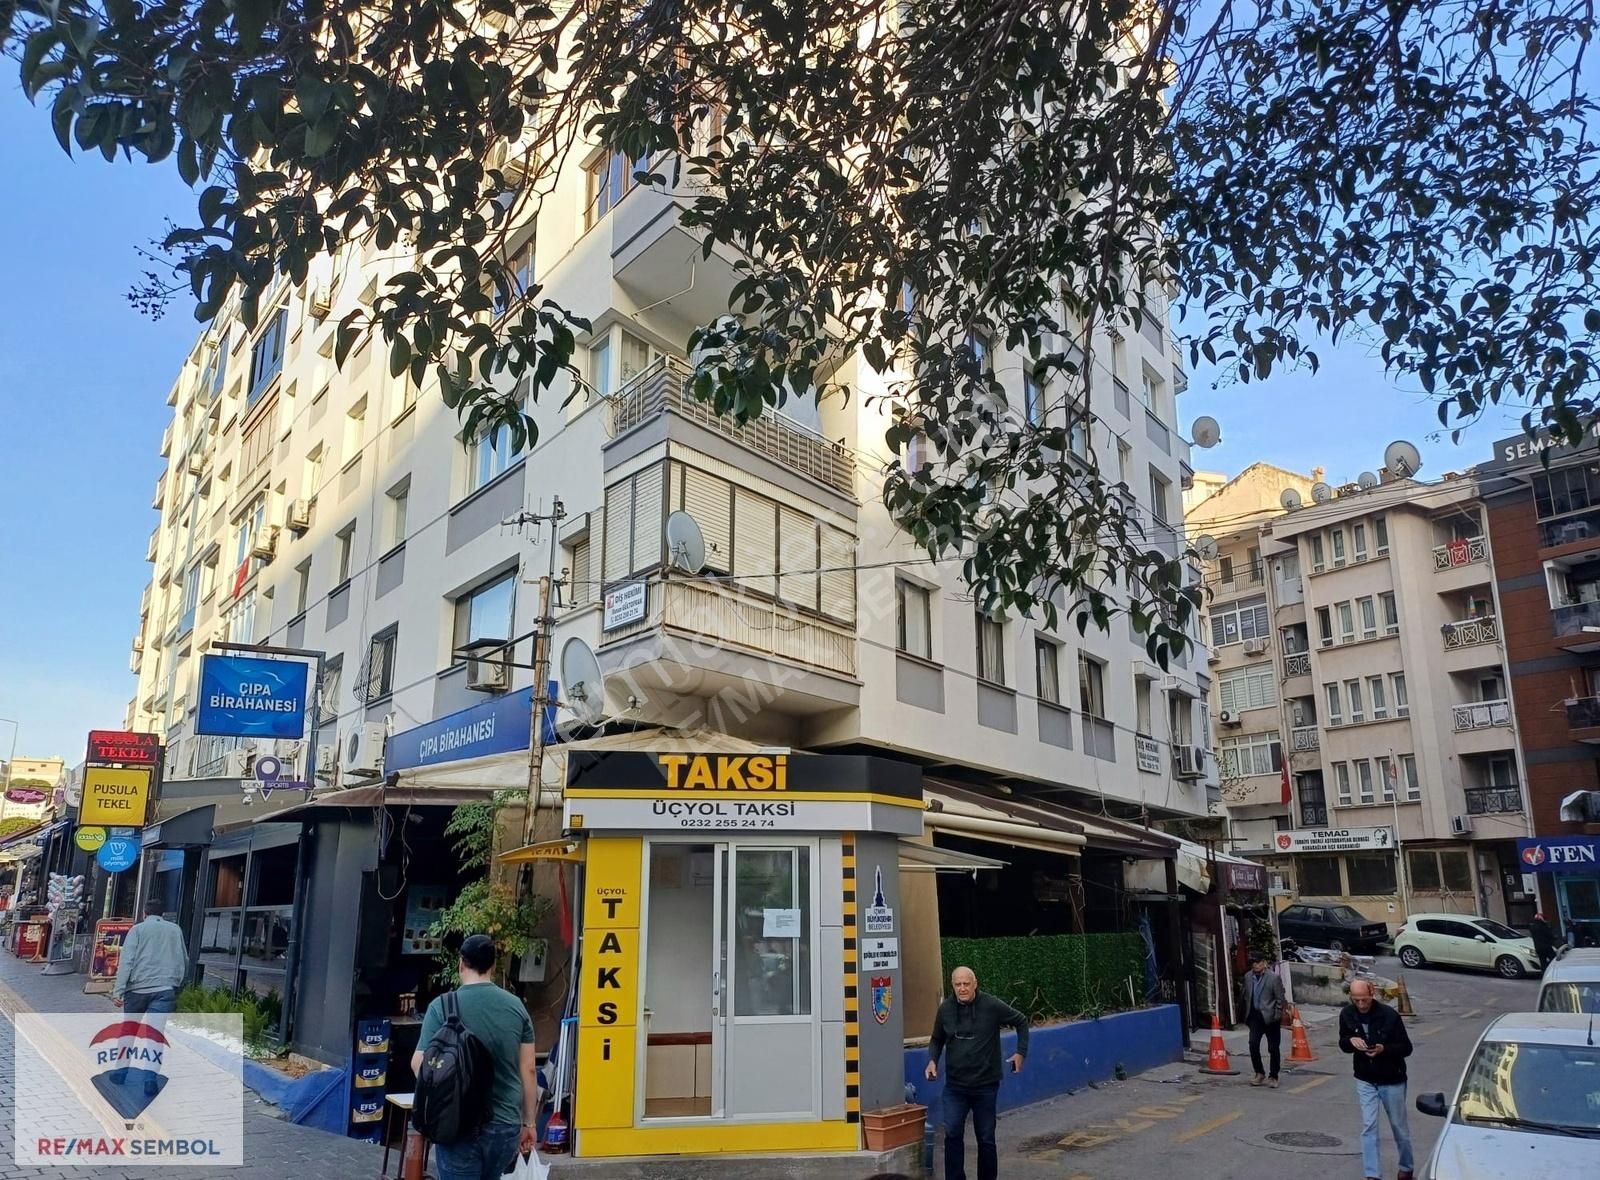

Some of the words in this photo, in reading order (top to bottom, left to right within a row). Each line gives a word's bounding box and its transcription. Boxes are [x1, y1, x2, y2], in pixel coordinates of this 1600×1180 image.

[240, 682, 272, 697] ÇIPA
[210, 693, 297, 712] BİRAHANESİ
[419, 736, 438, 762] ÇIPA
[439, 711, 496, 753] BİRAHANESİ
[98, 746, 149, 759] TEKEL
[658, 754, 788, 790] TAKSİ
[93, 783, 138, 796] PUSULA
[97, 798, 132, 810] TEKEL
[652, 800, 728, 818] ÜÇYOL
[733, 801, 795, 816] TAKSİ
[681, 819, 712, 827] 0232
[715, 819, 738, 827] 255
[741, 819, 756, 827] 24
[760, 819, 774, 827] 74
[1311, 830, 1349, 838] TEMAD
[1547, 845, 1596, 863] FEN
[596, 887, 627, 896] ÜÇYOL
[366, 1035, 383, 1043] EFES
[363, 1068, 380, 1077] EFES
[360, 1103, 377, 1111] EFES
